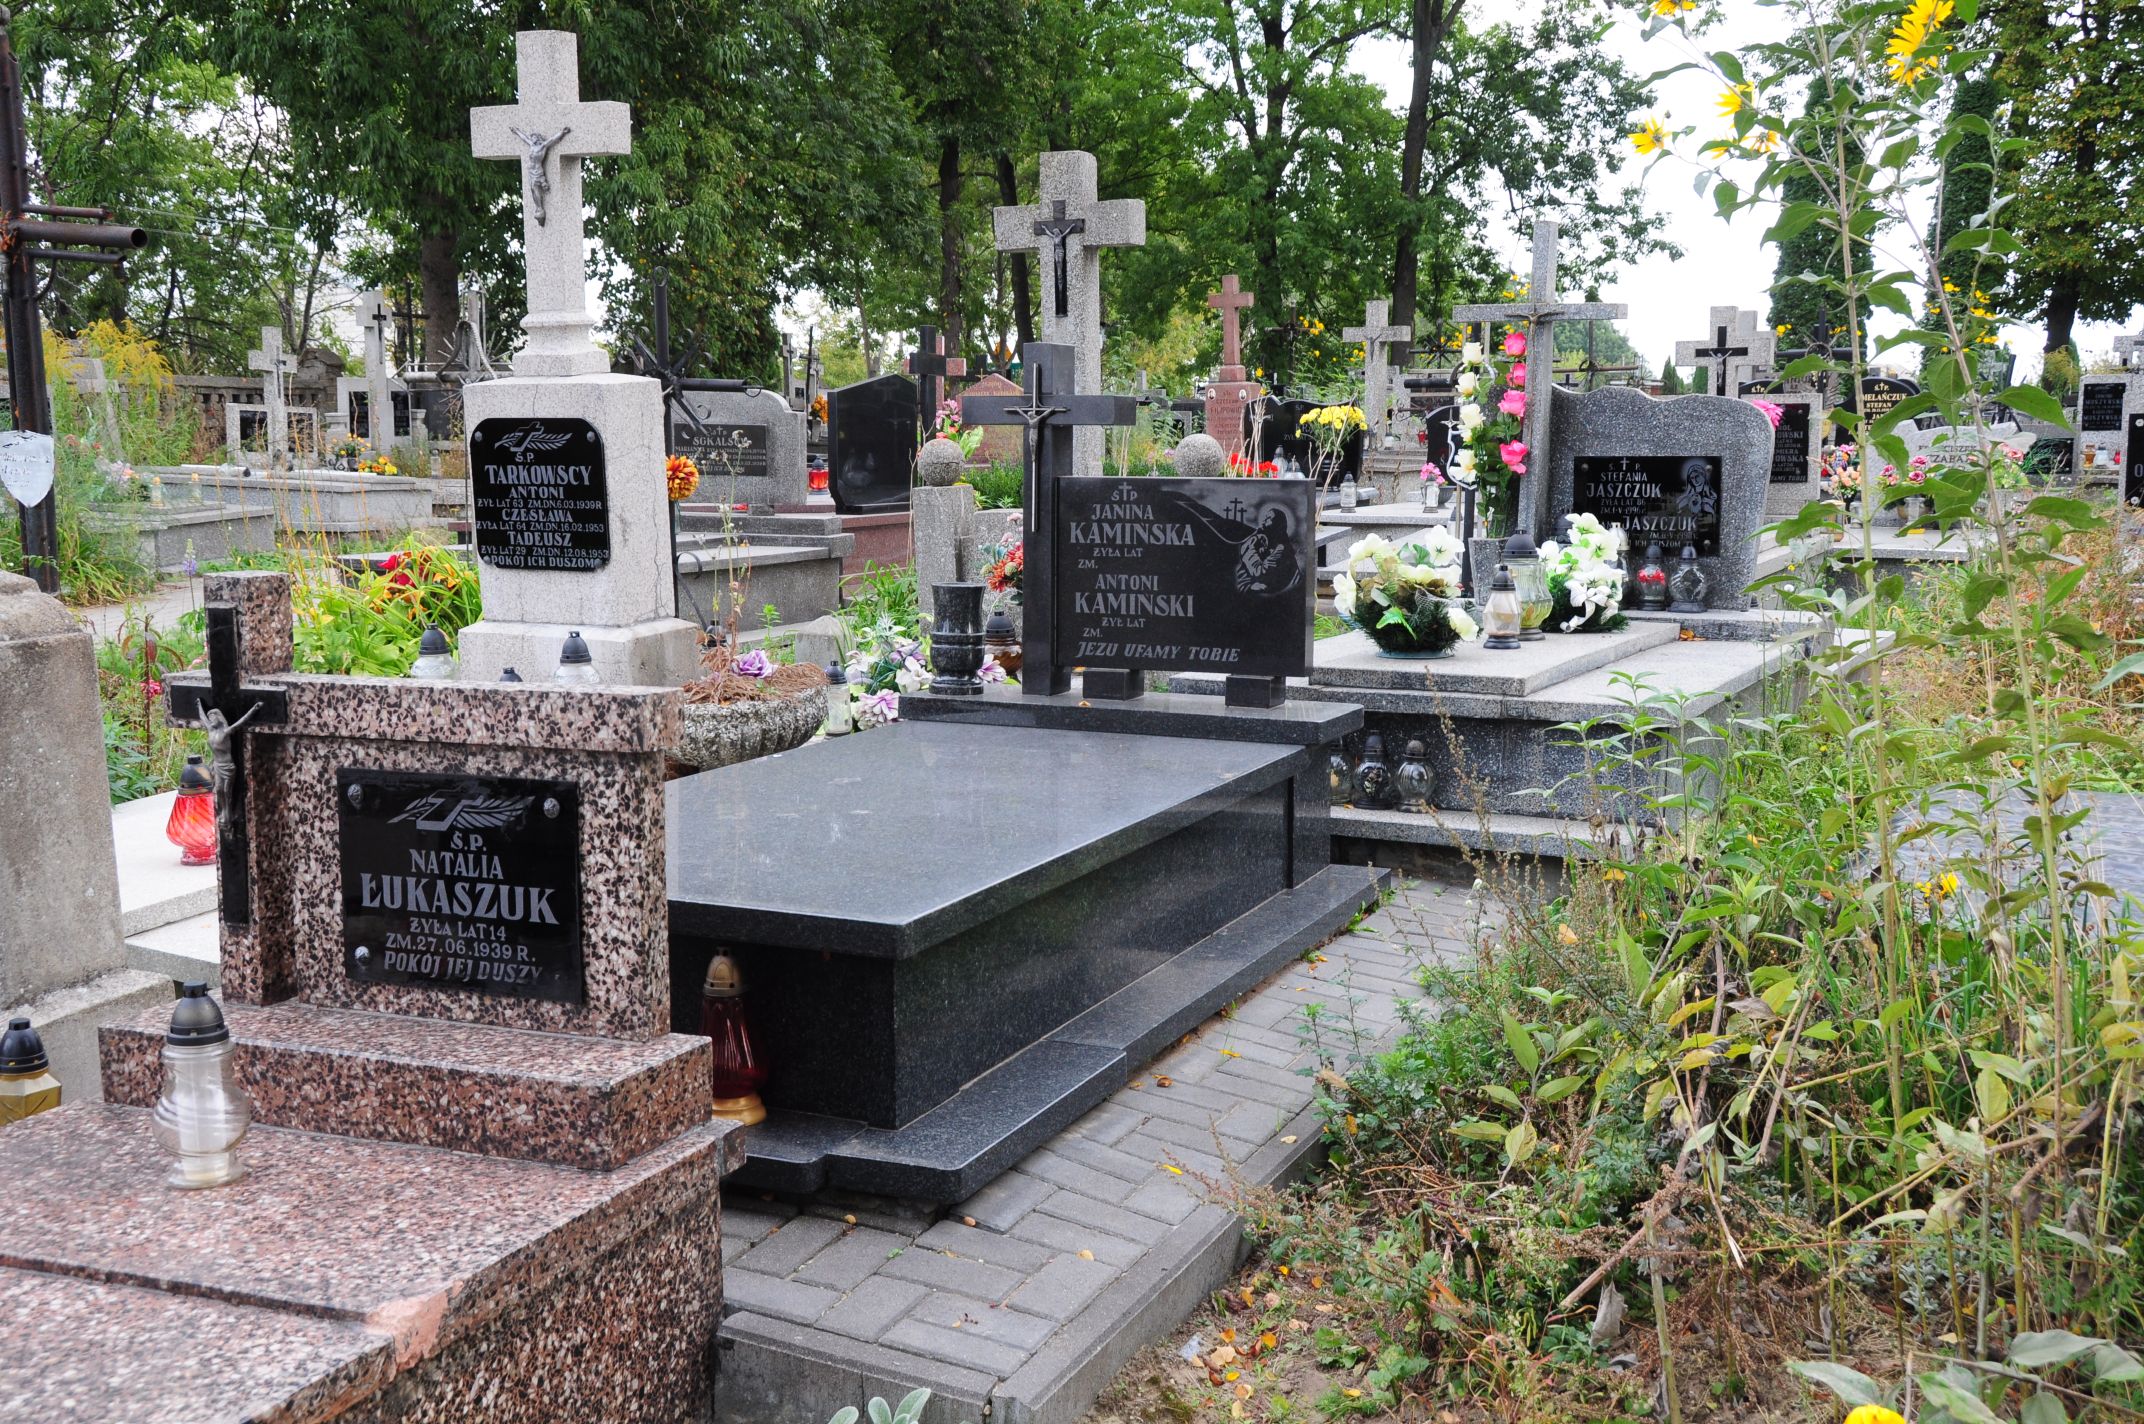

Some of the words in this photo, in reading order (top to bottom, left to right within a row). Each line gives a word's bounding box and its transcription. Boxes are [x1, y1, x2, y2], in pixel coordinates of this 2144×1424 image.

[485, 465, 592, 485] TARKOWSCY
[1601, 471, 1648, 482] STEFANIA
[509, 486, 565, 499] ANTONI
[1586, 483, 1662, 498] JASZCZUK
[497, 499, 511, 508] LAT
[513, 500, 523, 508] 63
[502, 509, 574, 522] CZESŁAWA
[1091, 503, 1155, 521] JANINA
[500, 521, 514, 530] LAT
[516, 522, 527, 530] 64
[1622, 515, 1697, 531] JASZCZUK
[507, 531, 572, 547] TADEUSZ
[1069, 521, 1196, 546] KAMIŃSKA
[500, 546, 514, 555] LAT
[516, 547, 526, 555] 29
[1093, 546, 1121, 558] ŻYŁA
[1124, 548, 1143, 558] LAT
[491, 554, 525, 567] POKÓJ
[528, 557, 546, 567] ICH
[550, 557, 595, 568] DUSZOM
[1078, 559, 1098, 569] ZM.
[1096, 574, 1159, 592] ANTONI
[1127, 618, 1146, 628] LAT
[1083, 627, 1103, 638] ZM.
[1075, 641, 1119, 658] JEZU
[1124, 643, 1181, 660] UFAMY
[1188, 646, 1241, 663] TOBIE
[409, 849, 504, 880] NATALIA
[360, 873, 560, 925] ŁUKASZUK
[410, 917, 452, 936] ŻYŁA
[384, 949, 441, 978] POKÓJ
[446, 957, 474, 982] JEJ
[477, 961, 543, 985] DUSZY
